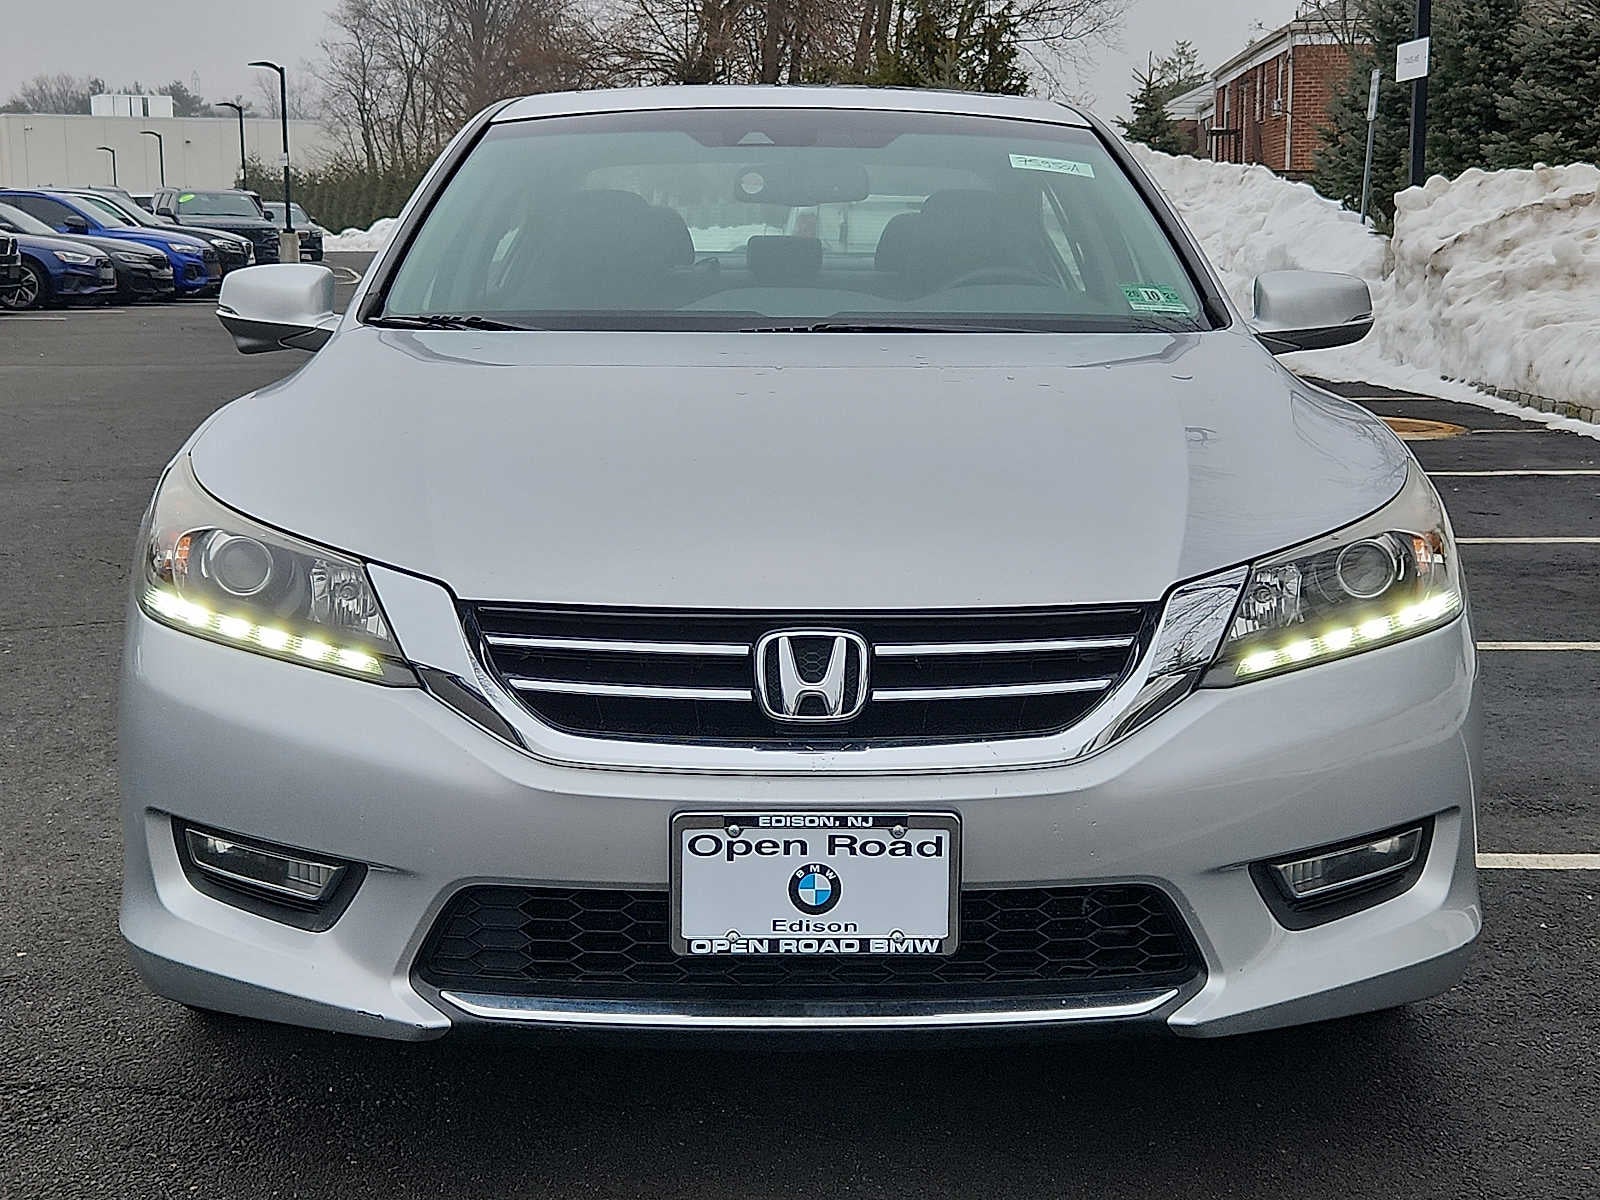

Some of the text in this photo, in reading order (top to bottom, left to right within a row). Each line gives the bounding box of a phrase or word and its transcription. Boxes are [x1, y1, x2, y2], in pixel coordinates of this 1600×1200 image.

[1142, 290, 1161, 301] 10
[758, 816, 873, 827] EDISON, NJ
[687, 834, 944, 862] Open Road
[795, 864, 837, 880] BMW
[772, 919, 858, 933] Edison
[691, 939, 940, 954] OPEN ROAD BMW
